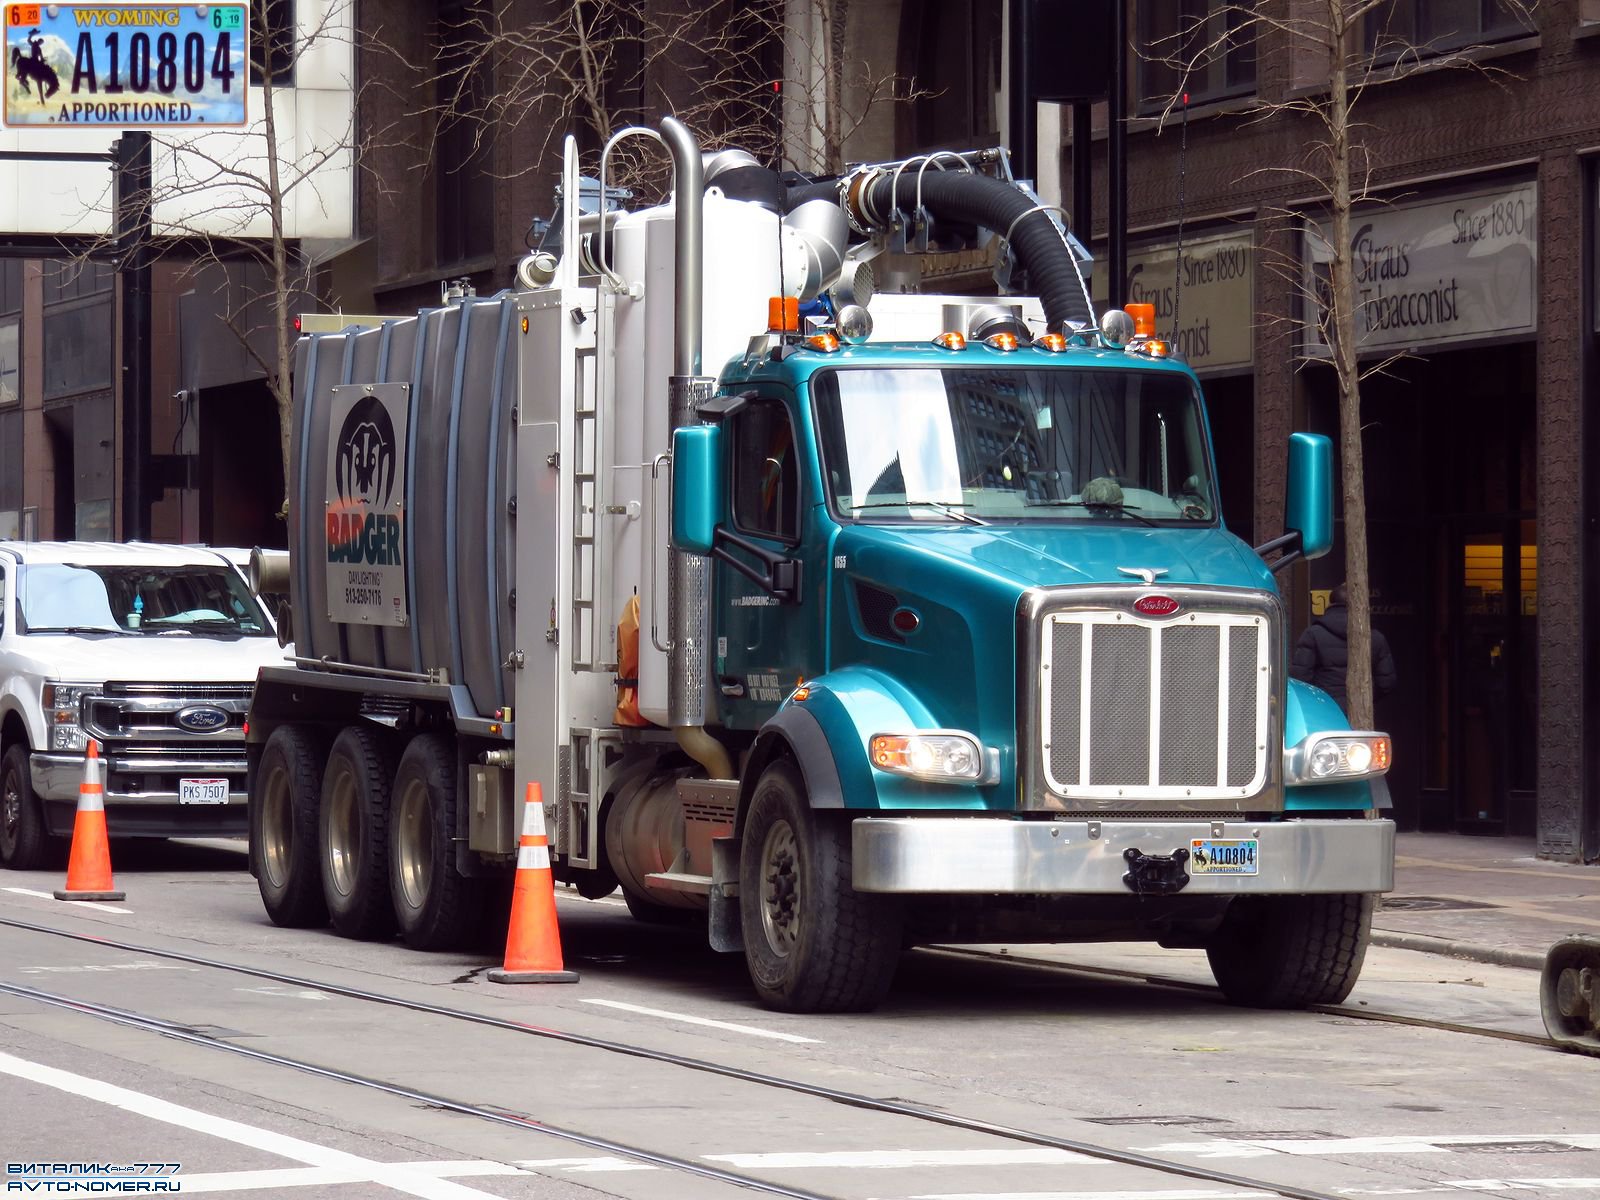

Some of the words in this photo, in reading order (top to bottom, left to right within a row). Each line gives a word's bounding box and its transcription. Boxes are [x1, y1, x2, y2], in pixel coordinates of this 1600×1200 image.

[1452, 209, 1487, 244] Since
[1491, 199, 1526, 236] 1880
[1183, 254, 1214, 287] Since
[1216, 245, 1246, 281] 1880
[1357, 238, 1410, 284] Straus
[1360, 278, 1459, 332] Tobacconist
[327, 512, 402, 566] BADGER
[191, 713, 217, 725] Ford
[183, 785, 201, 799] PKS
[203, 785, 226, 798] 7507
[1210, 848, 1254, 865] A10804
